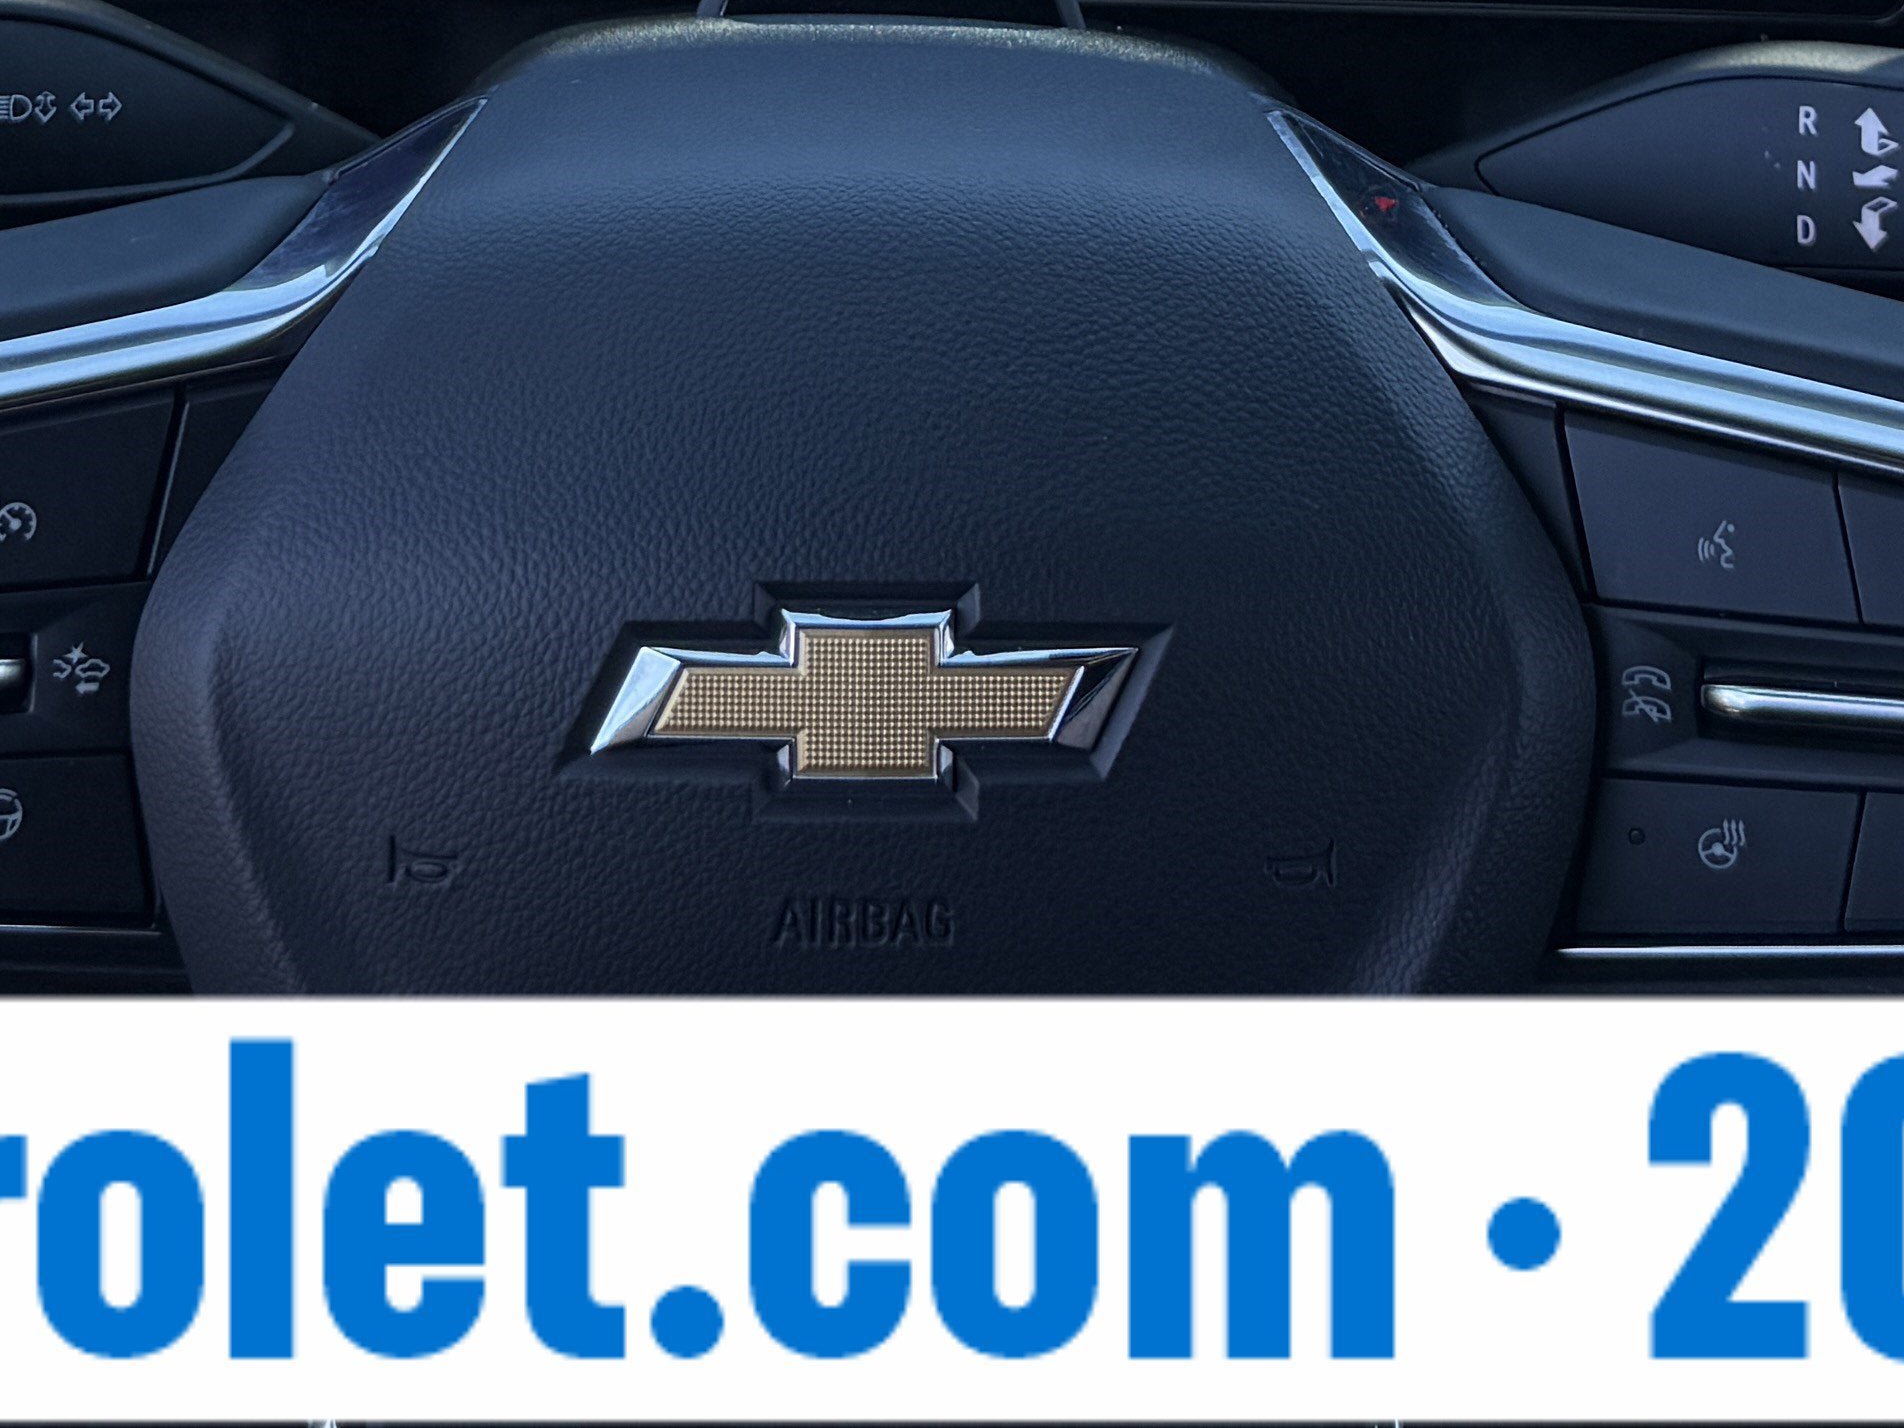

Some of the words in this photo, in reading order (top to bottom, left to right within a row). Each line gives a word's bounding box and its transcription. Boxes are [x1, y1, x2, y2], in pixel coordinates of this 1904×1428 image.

[1798, 106, 1818, 136] R
[1798, 161, 1817, 191] N
[1797, 216, 1817, 245] D
[771, 899, 954, 946] AIRBAG
